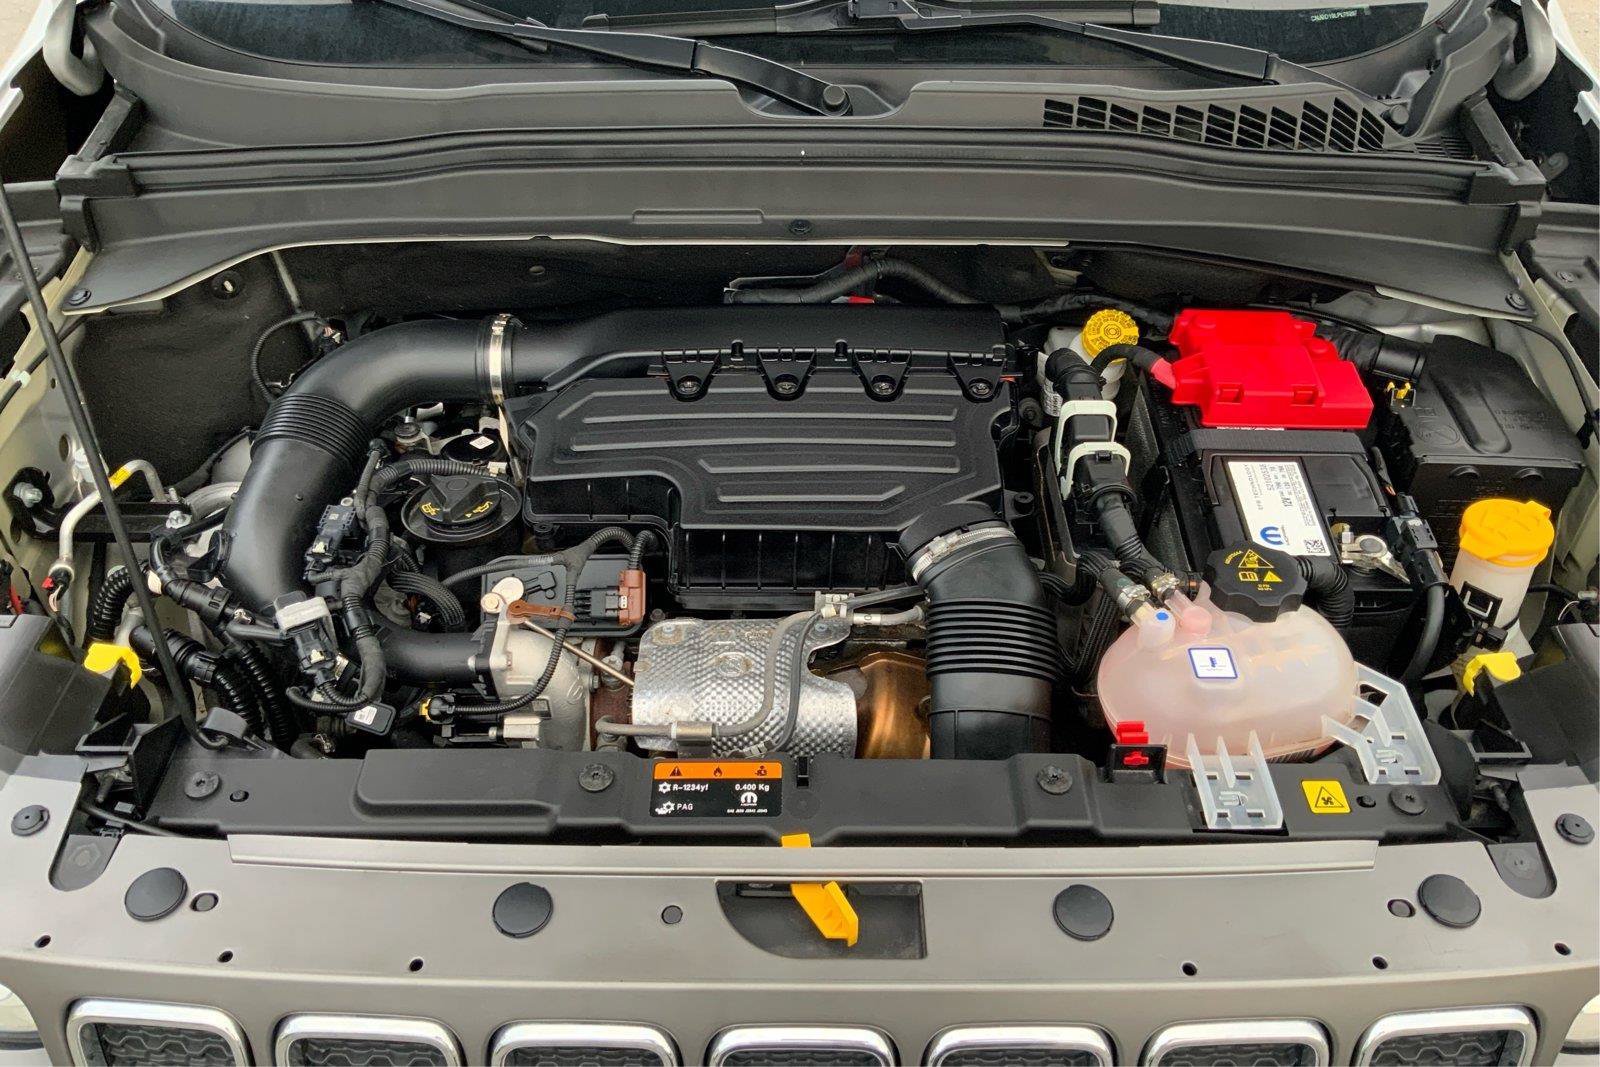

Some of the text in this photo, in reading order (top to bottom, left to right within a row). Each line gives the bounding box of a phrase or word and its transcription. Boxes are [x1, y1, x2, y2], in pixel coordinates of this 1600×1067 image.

[672, 783, 709, 792] R-1234yf
[734, 783, 770, 792] 0.400 Kg
[676, 803, 694, 811] PAG
